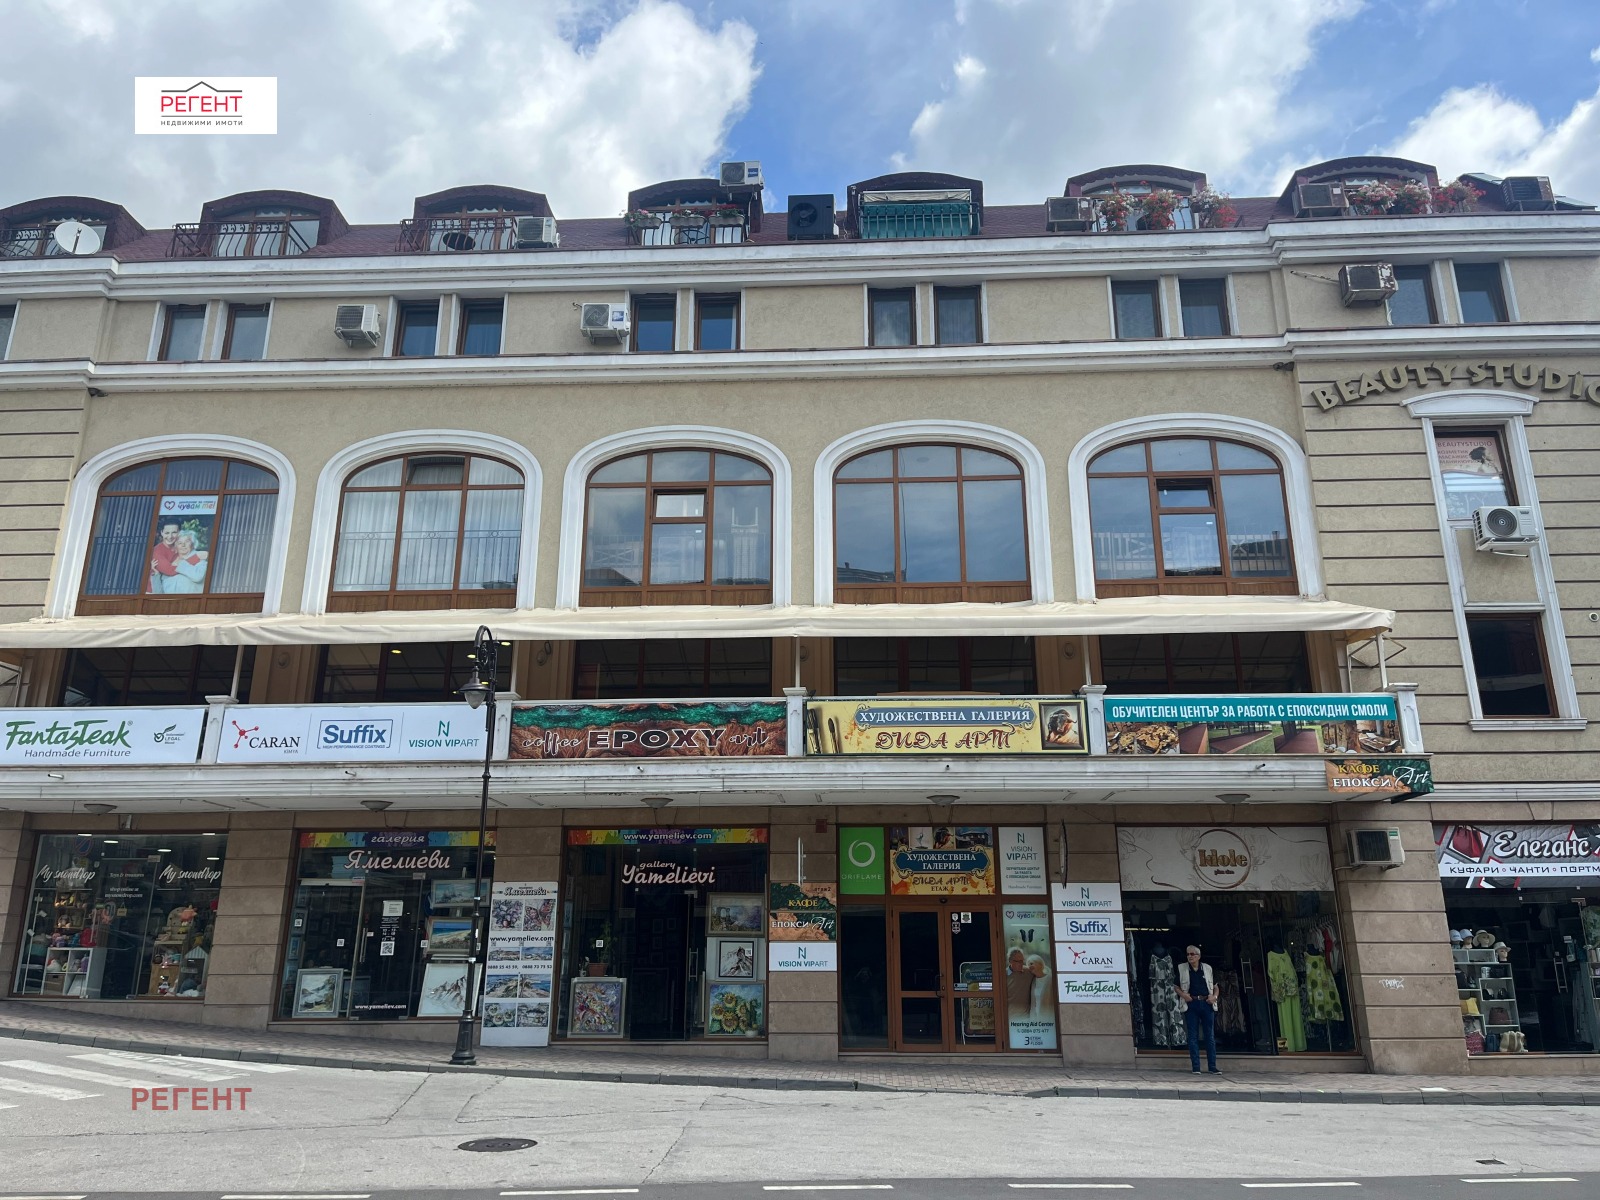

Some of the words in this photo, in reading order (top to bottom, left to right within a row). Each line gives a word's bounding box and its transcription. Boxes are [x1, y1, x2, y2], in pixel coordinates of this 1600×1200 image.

[1311, 361, 1457, 412] BEAUTY
[860, 710, 966, 724] ХУДОЖЕСТВЕНА
[971, 711, 1031, 721] ГАЛЕРИЯ
[1112, 706, 1178, 718] ОБУЧИТЕЛЕН
[1180, 706, 1219, 719] ЦЕНТЪР
[1222, 706, 1235, 718] ЗА
[1238, 705, 1276, 718] РАБОТА
[1278, 705, 1285, 717] С
[1287, 704, 1349, 718] ЕПОКСИДНИ
[1352, 704, 1388, 717] СМОЛИ
[323, 724, 386, 743] Suffix
[875, 731, 948, 749] ДИДА
[249, 737, 300, 748] CARAN
[408, 739, 442, 748] VISION
[445, 739, 479, 747] VIPART
[522, 732, 582, 756] coffee
[588, 728, 726, 749] EPOXY
[729, 727, 770, 748] art
[24, 749, 81, 758] Handmade
[1338, 764, 1379, 774] КАФЕ
[1332, 778, 1391, 788] ЕПОКСИ
[1392, 767, 1430, 786] Art
[371, 835, 425, 844] галерия
[1492, 830, 1591, 859] Елеганс
[344, 850, 450, 869] Ямелиеви
[907, 853, 976, 861] ХУДОЖЕСТВЕНА
[1198, 849, 1248, 866] Idole
[639, 861, 675, 870] gallery
[923, 862, 961, 870] ГАЛЕРИЯ
[36, 864, 53, 882] My
[53, 866, 96, 882] snowdrop
[159, 864, 176, 883] My
[177, 866, 221, 882] snowdrop
[622, 864, 716, 884] Yamelievi
[788, 899, 818, 907] КАФЕ
[1070, 921, 1108, 933] Suffix
[1024, 1037, 1030, 1045] 3
